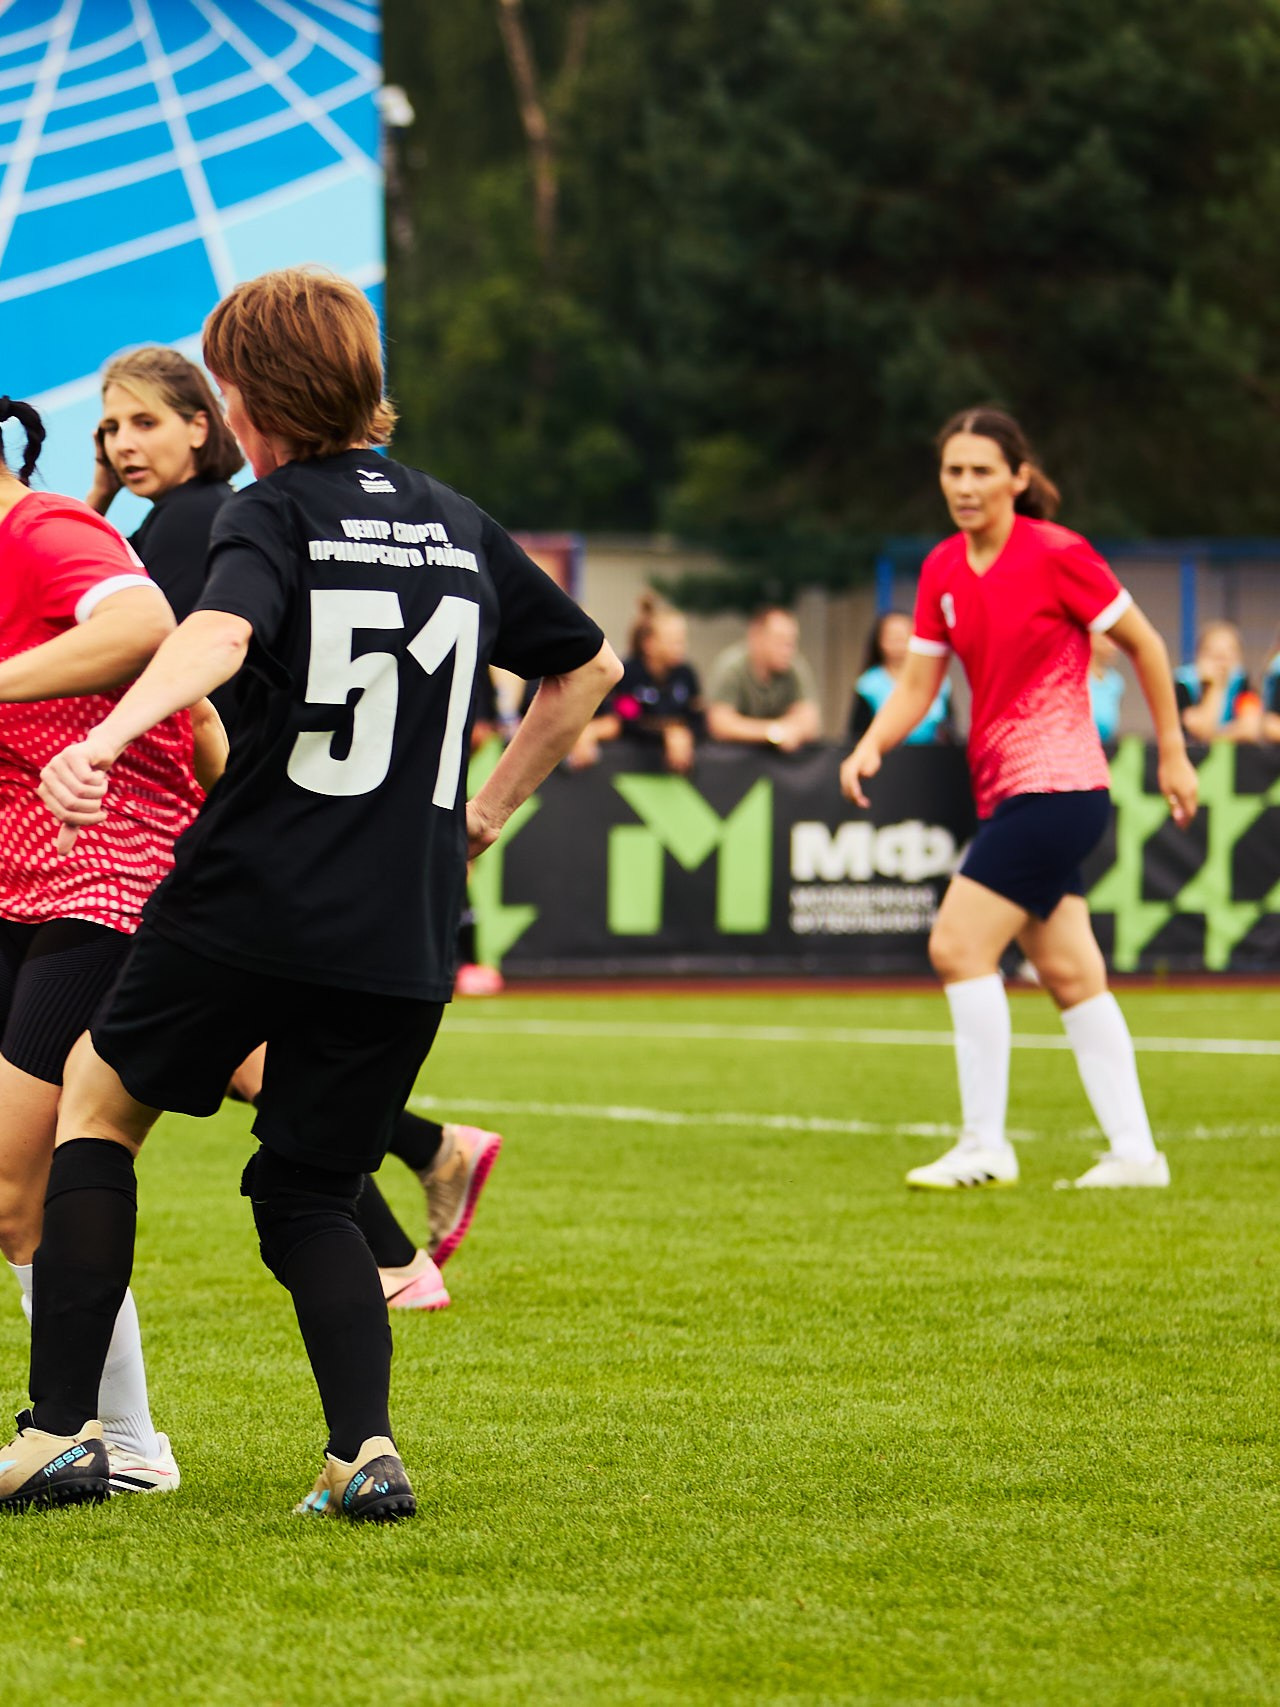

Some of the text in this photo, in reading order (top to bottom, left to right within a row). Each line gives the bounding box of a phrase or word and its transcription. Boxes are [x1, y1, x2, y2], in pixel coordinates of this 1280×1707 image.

[340, 519, 392, 541] ЦЕНТР
[287, 589, 481, 811] 51
[43, 1444, 88, 1478] MESSI
